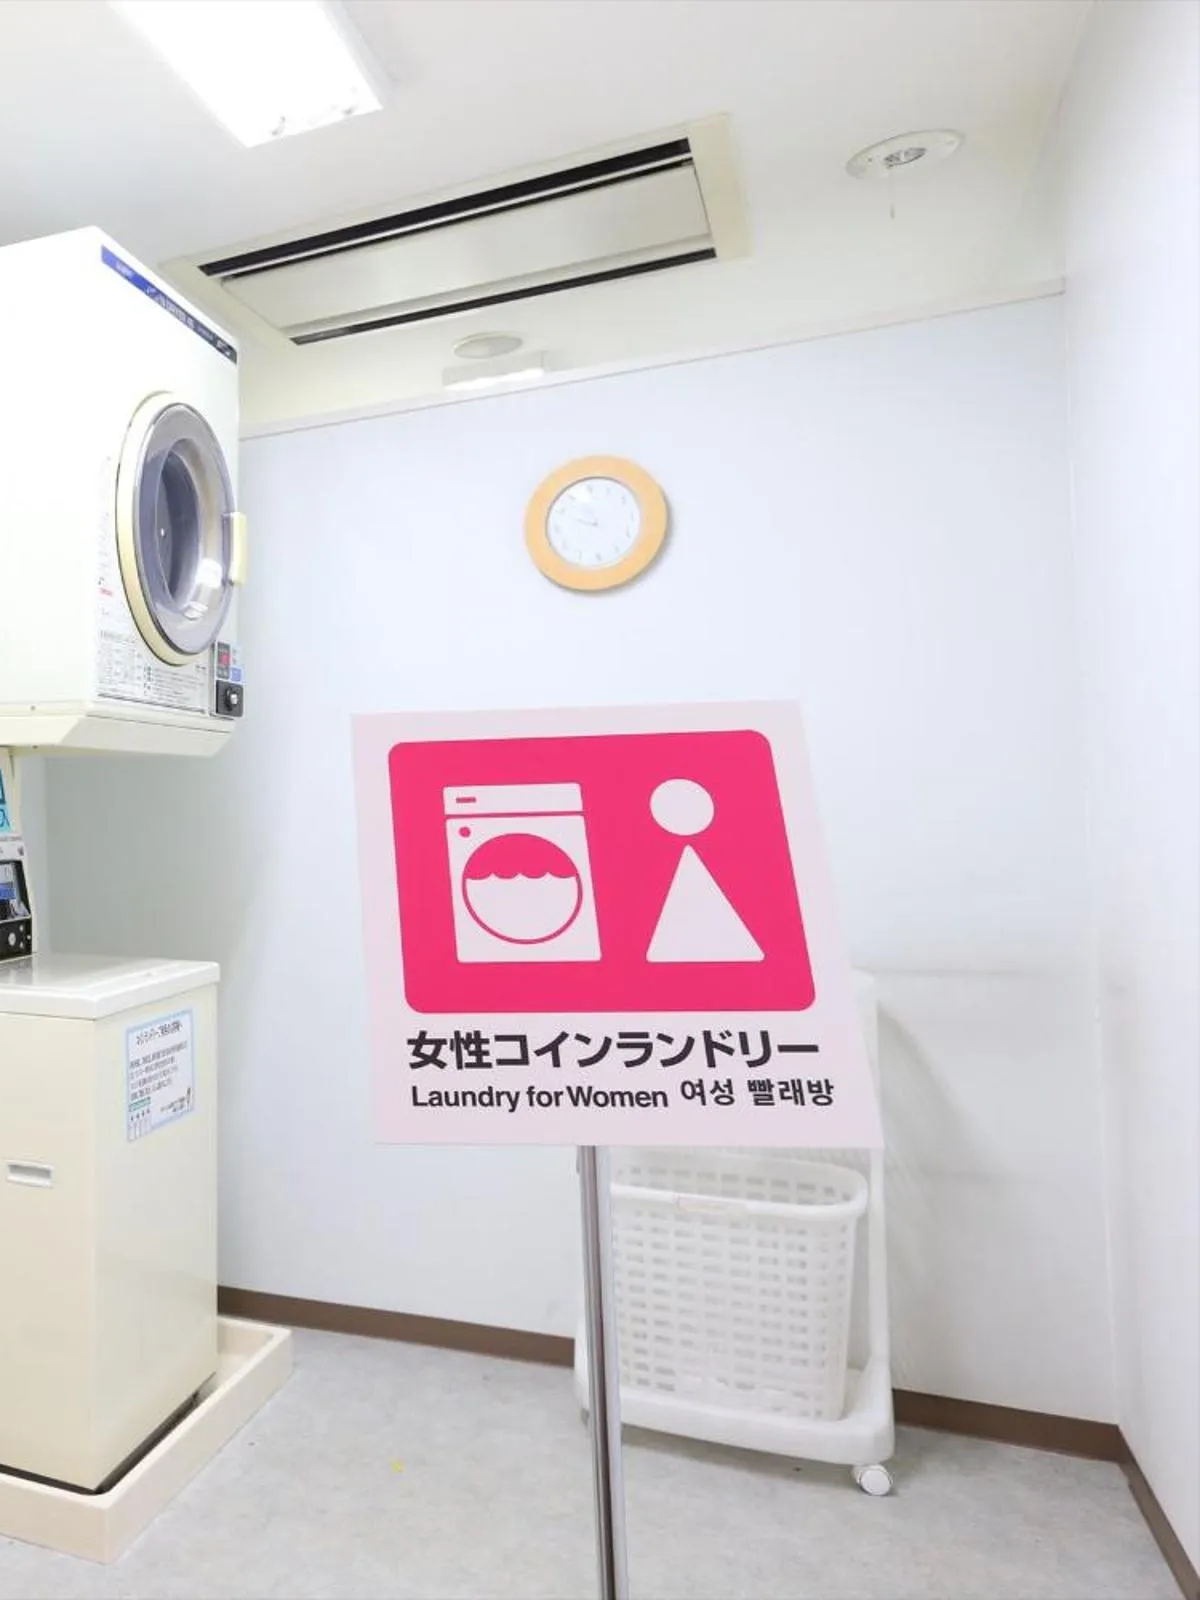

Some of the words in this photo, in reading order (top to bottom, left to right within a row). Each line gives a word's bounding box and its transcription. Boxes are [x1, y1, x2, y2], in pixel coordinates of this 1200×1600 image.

[407, 1030, 819, 1070] 女性コインランドリー
[411, 1085, 520, 1112] Laundry
[526, 1085, 563, 1107] for
[566, 1085, 669, 1107] Women
[680, 1078, 735, 1106] 여성
[747, 1078, 835, 1106] 빨래방
